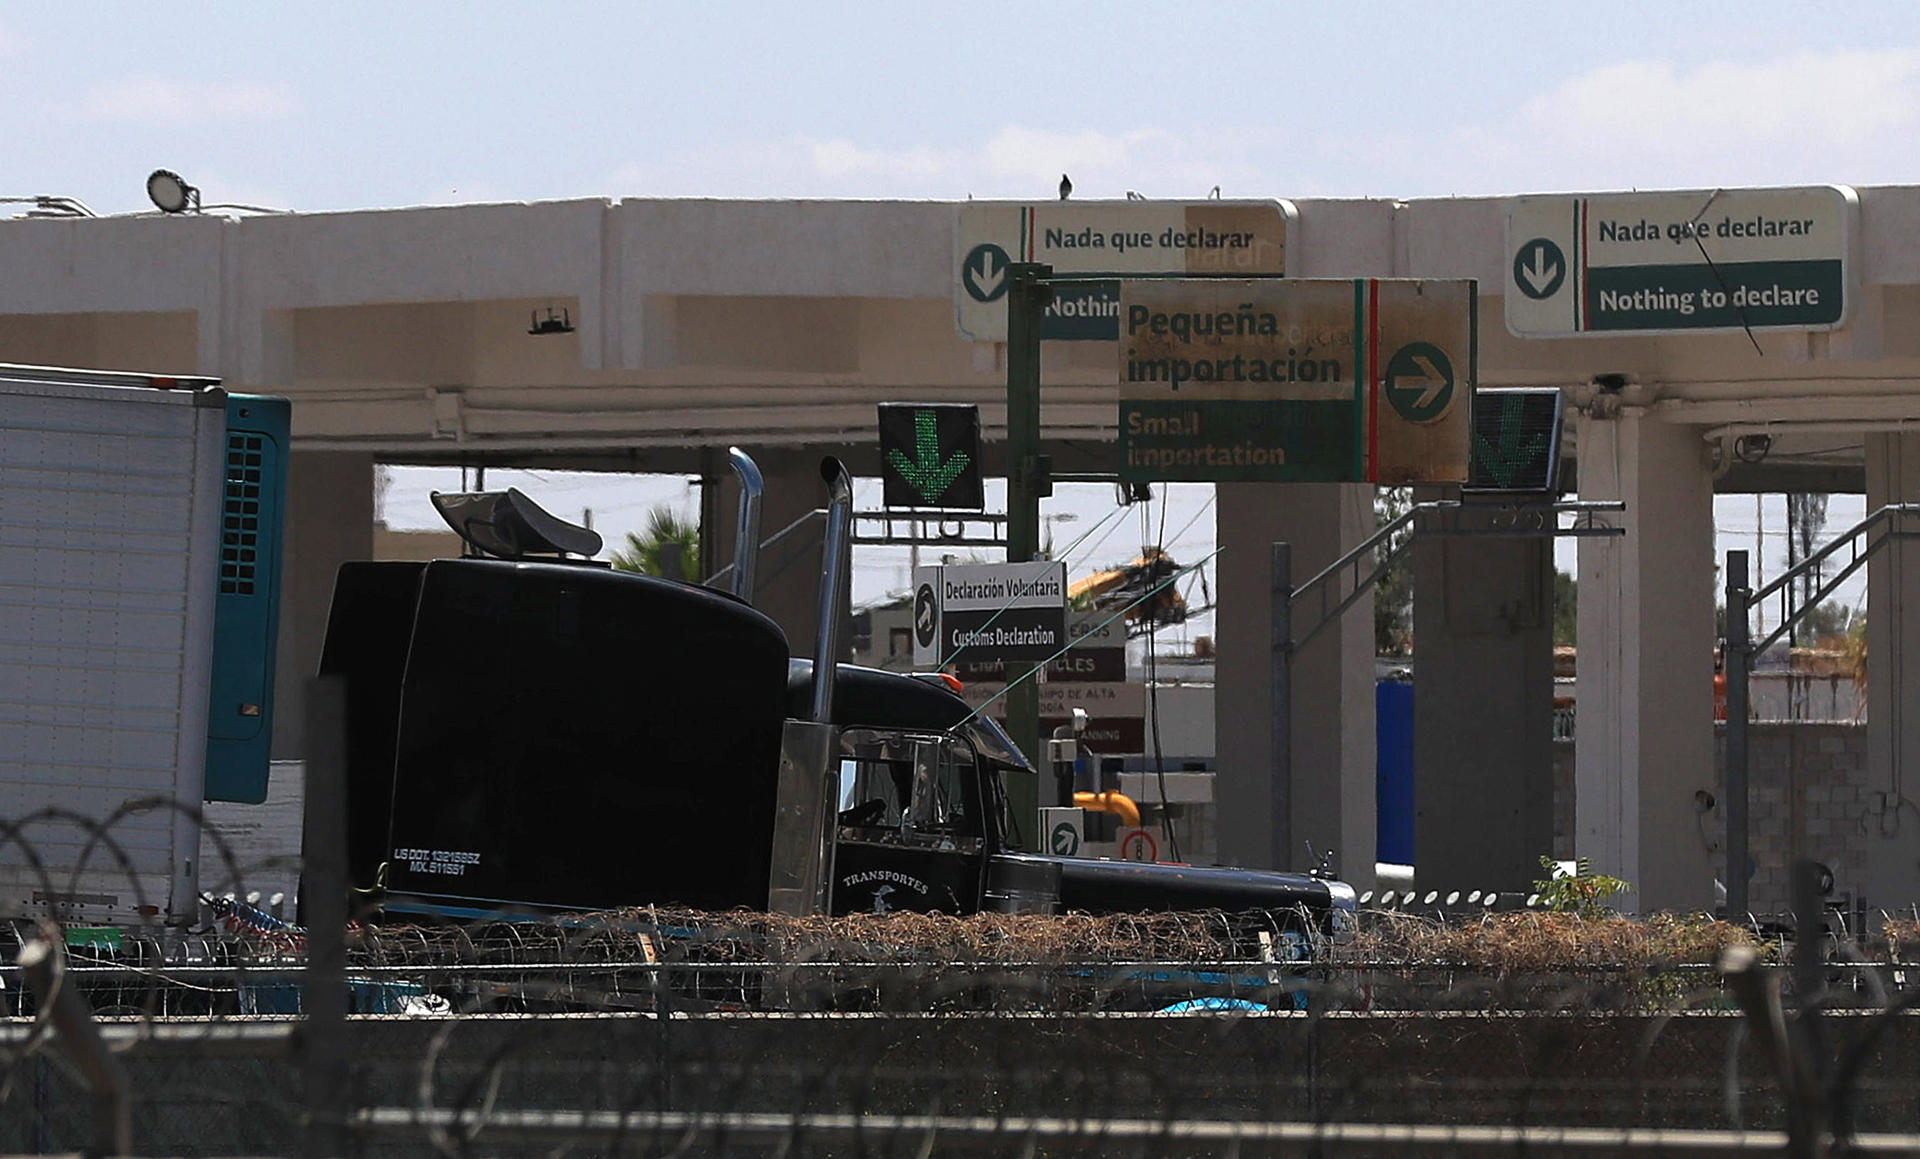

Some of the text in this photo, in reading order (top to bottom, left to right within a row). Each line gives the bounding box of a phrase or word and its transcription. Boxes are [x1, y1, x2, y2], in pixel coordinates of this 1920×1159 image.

[1045, 228, 1254, 253] Nada que declarar
[1600, 216, 1814, 245] Nada que declarar
[1045, 294, 1119, 317] Nothin
[1600, 284, 1819, 315] Nothing to declare
[1128, 303, 1279, 343] Pequeña
[1127, 347, 1341, 390] importación
[1127, 410, 1200, 435] Small
[1127, 441, 1286, 471] importation
[946, 577, 1059, 599] Declaración Voluntaria
[952, 625, 1055, 647] Customs Declaration
[394, 848, 408, 860] US
[843, 870, 929, 895] TRANSPORTES
